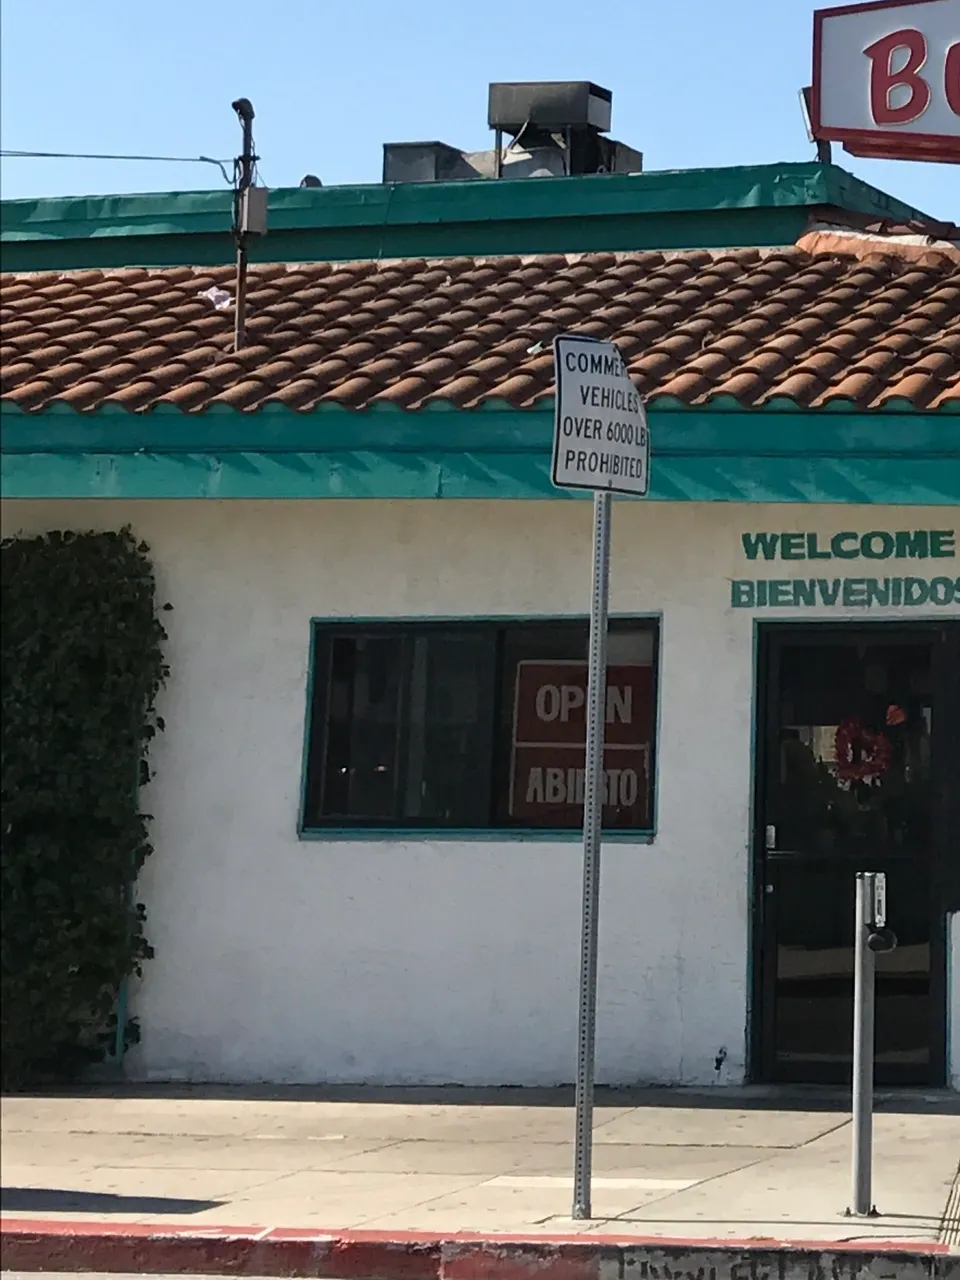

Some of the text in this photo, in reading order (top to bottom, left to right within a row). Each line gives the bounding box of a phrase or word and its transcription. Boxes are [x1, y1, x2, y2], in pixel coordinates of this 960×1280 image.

[580, 384, 639, 414] VEHICLES
[563, 416, 603, 440] OVER
[606, 421, 634, 445] 6000
[565, 449, 643, 479] PROHIBITED
[741, 529, 956, 561] WELCOME
[535, 684, 632, 724] OPN
[526, 767, 638, 807] ABITO
